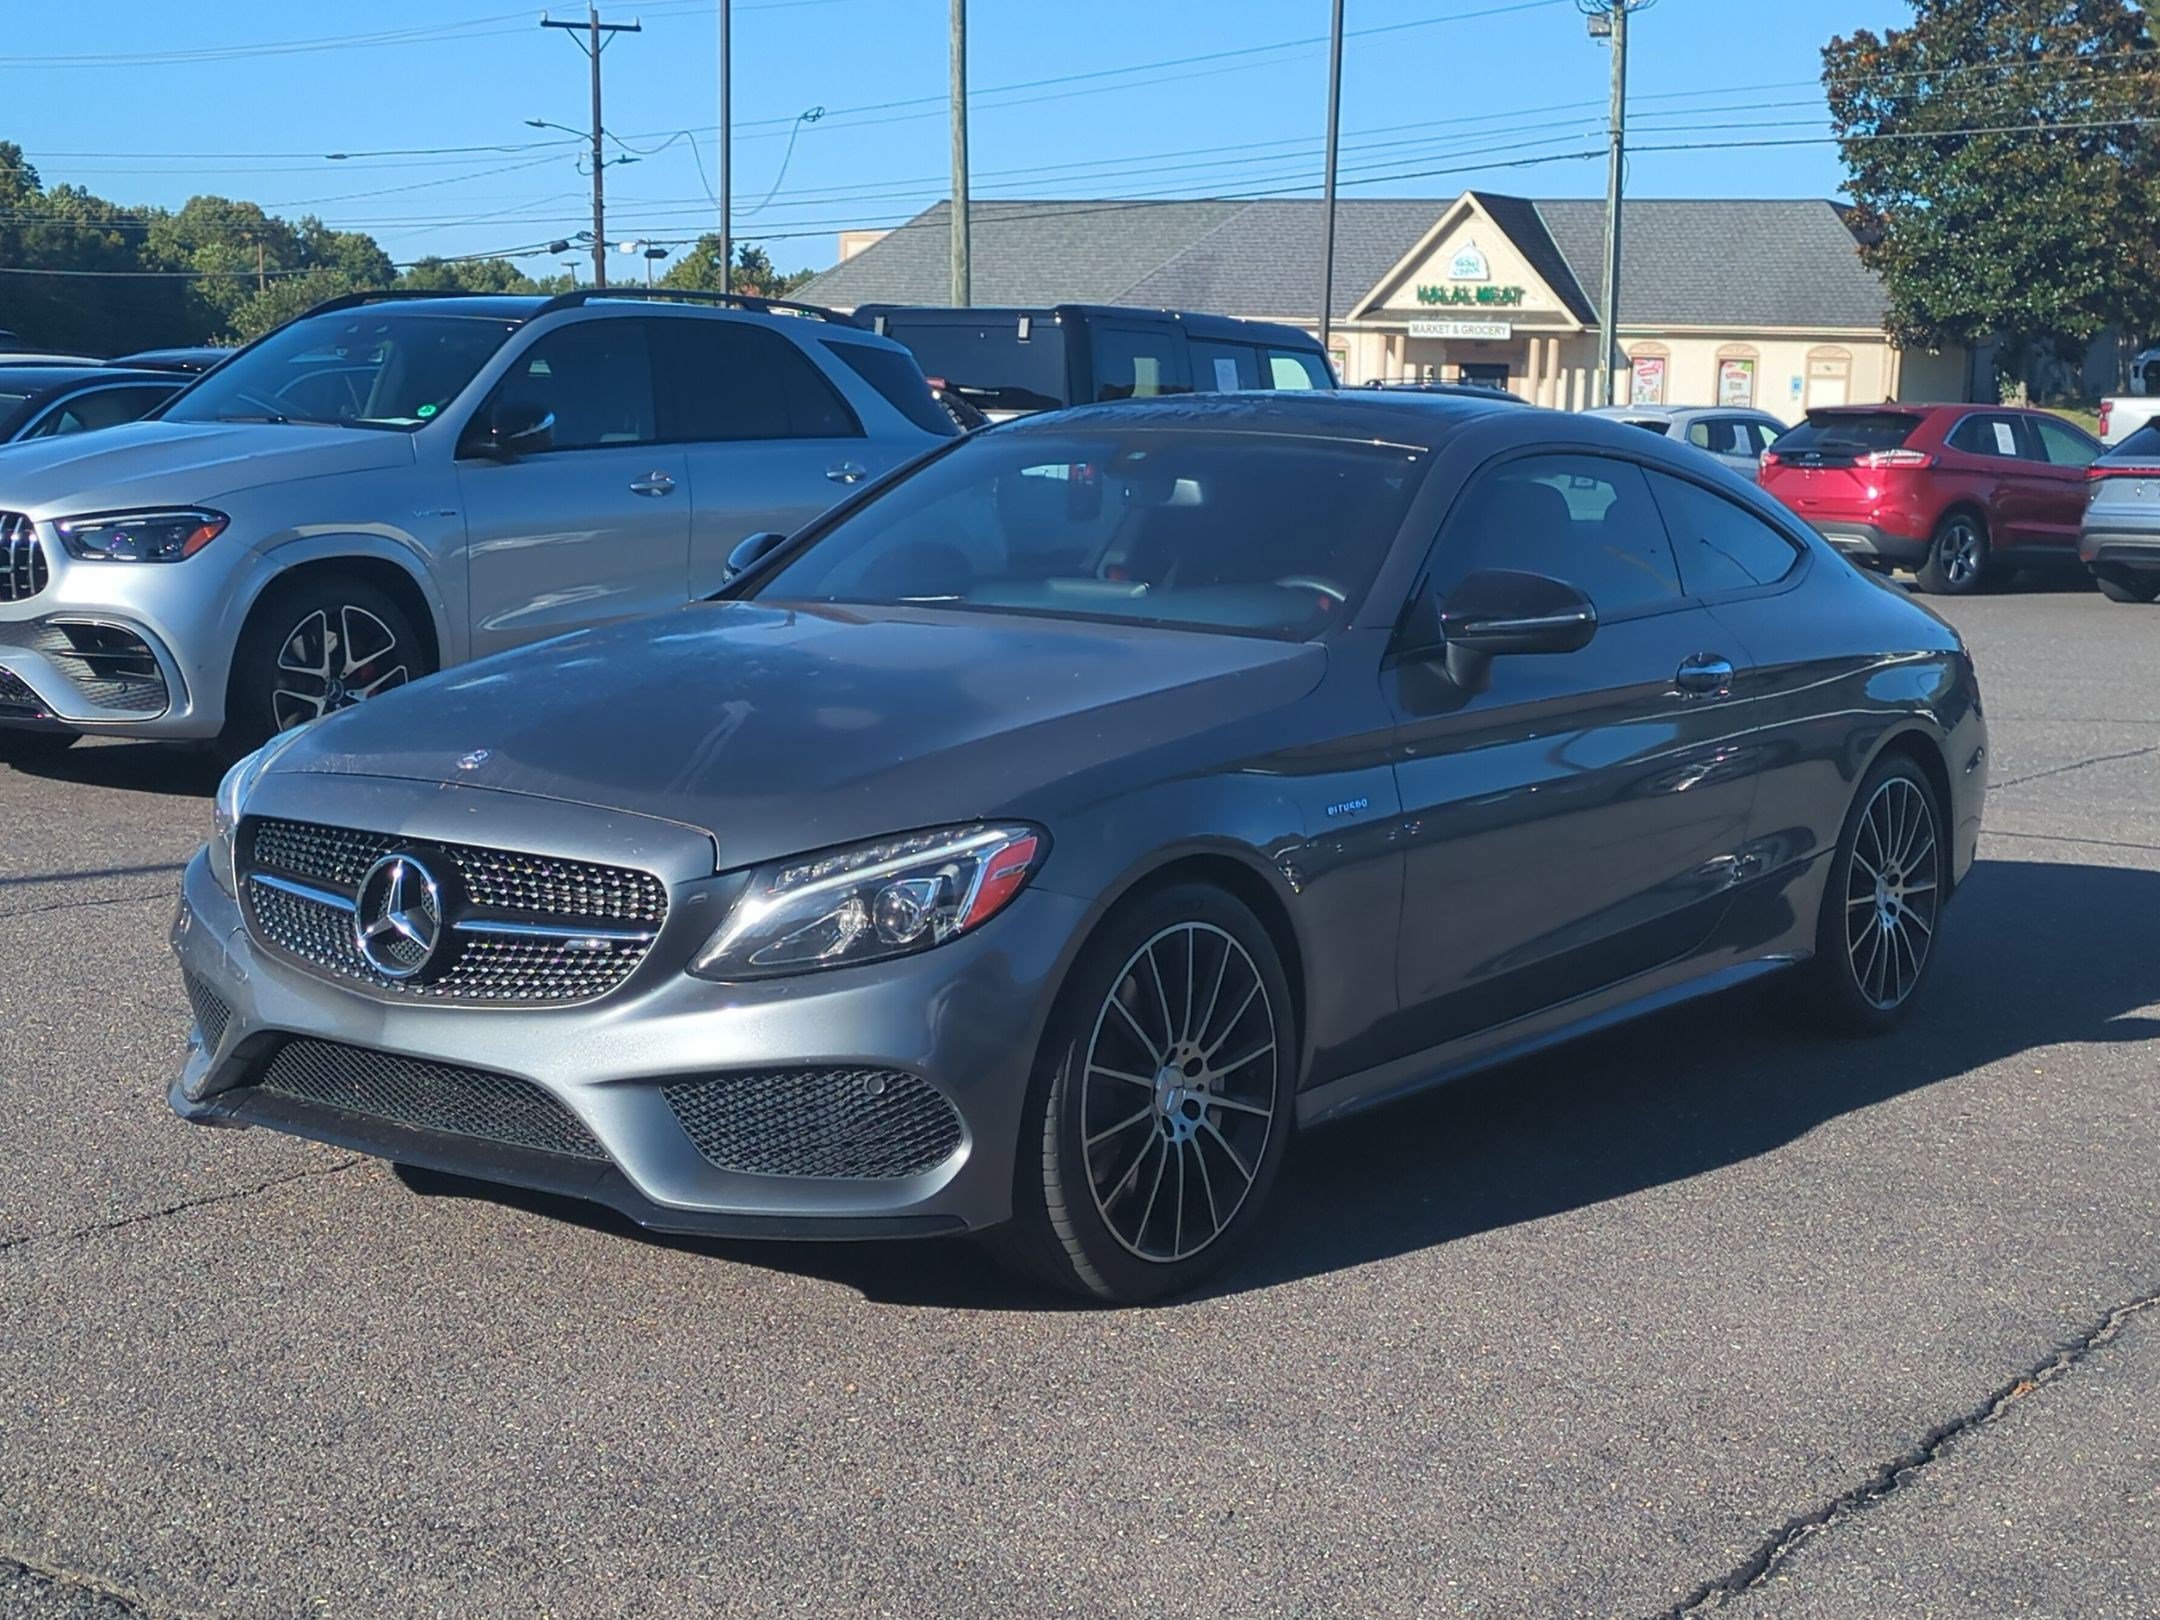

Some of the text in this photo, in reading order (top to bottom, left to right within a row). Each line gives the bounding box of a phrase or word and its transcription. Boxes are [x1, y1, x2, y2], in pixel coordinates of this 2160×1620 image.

[1477, 286, 1525, 306] MEAT
[1411, 324, 1507, 336] MARKET & GROCERY
